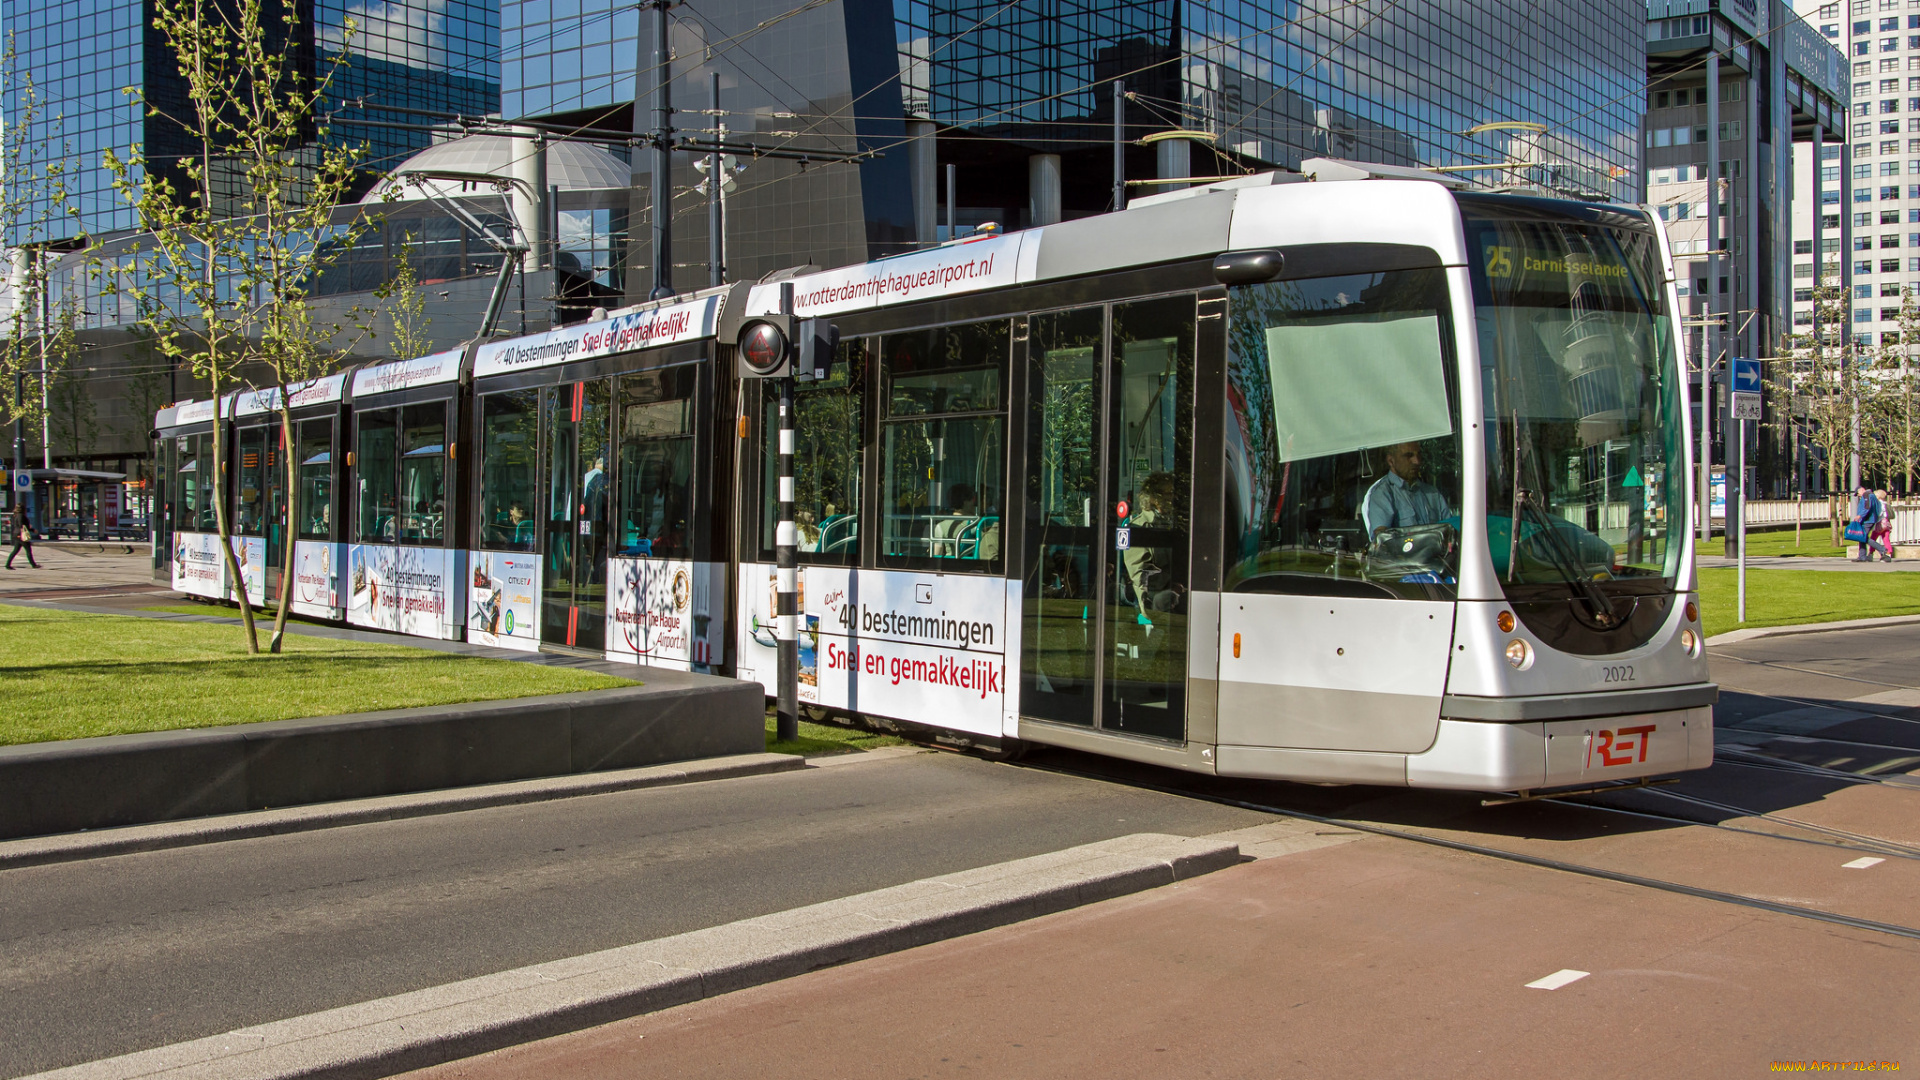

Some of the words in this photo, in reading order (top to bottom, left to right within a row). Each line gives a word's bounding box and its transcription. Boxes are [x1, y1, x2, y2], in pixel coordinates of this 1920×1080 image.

[1486, 245, 1512, 278] 25
[1523, 256, 1629, 277] Carnisselande
[779, 252, 995, 312] w.rotterdamthehagueairport.nl
[503, 347, 514, 365] 40
[515, 337, 579, 364] bestemmingen
[582, 328, 605, 352] Snel
[604, 329, 619, 347] en
[619, 311, 690, 351] gemakkelijk!
[395, 568, 441, 591] bestemmingen
[405, 594, 445, 619] gemakkelijk!
[615, 608, 647, 626] Rotterdam
[648, 610, 659, 627] The
[660, 612, 680, 632] Hague
[657, 632, 688, 651] Airport.nl
[839, 603, 858, 630] 40
[862, 603, 994, 650] bestemmingen
[828, 643, 860, 672] Snel
[865, 653, 885, 676] en
[891, 655, 1006, 700] gemakkelijk!
[1602, 665, 1636, 683] 2022
[1597, 724, 1657, 767] RET
